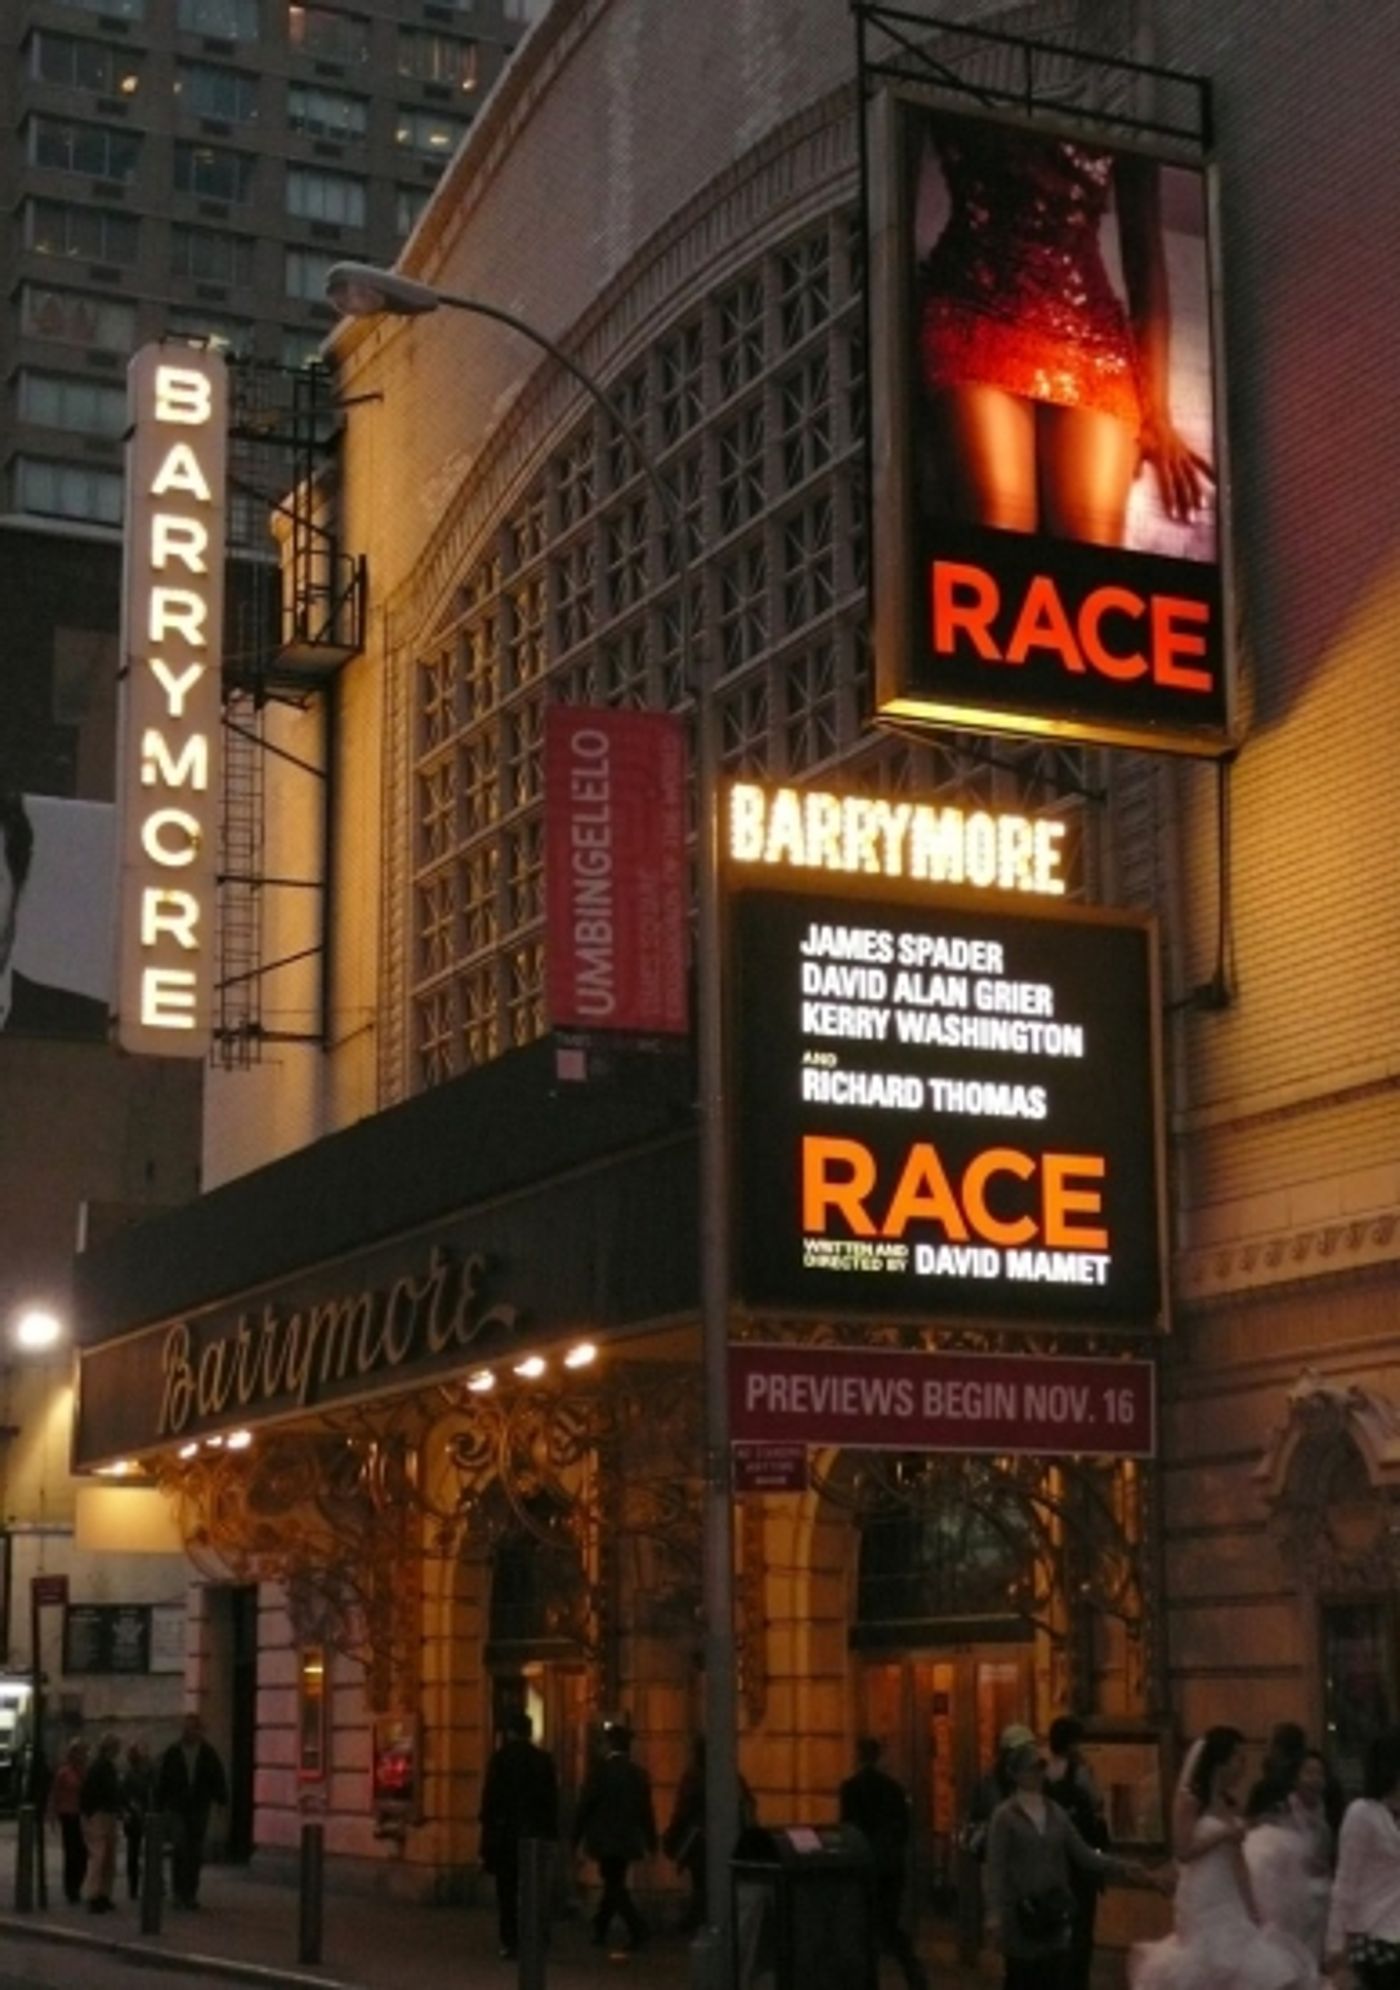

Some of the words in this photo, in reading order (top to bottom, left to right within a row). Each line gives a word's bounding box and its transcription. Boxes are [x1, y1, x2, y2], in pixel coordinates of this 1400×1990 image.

[931, 559, 1212, 692] RACE
[142, 366, 211, 1028] BARRYMORE
[731, 785, 1066, 894] BARRYMORE
[571, 729, 616, 1015] UMBINGELELO
[800, 924, 893, 962] JAMES
[898, 933, 1004, 973] SPADER
[802, 963, 887, 1000] DAVID
[893, 972, 968, 1008] ALAN
[975, 980, 1054, 1016] GRIER
[802, 1003, 890, 1040] KERRY
[895, 1010, 1084, 1057] WASHINGTON
[802, 1051, 837, 1068] AND
[802, 1068, 924, 1108] RICHARD
[929, 1079, 1047, 1119] THOMAS
[803, 1136, 1108, 1249] RACE
[886, 1258, 909, 1272] BY
[915, 1244, 1000, 1278] DAVID
[1006, 1250, 1111, 1285] MAMET
[156, 1246, 515, 1433] Barrymore
[746, 1373, 914, 1416] PREVIEWS
[922, 1380, 1016, 1421] BEGIN
[1024, 1384, 1096, 1425] NOV.
[1103, 1388, 1135, 1424] 16
